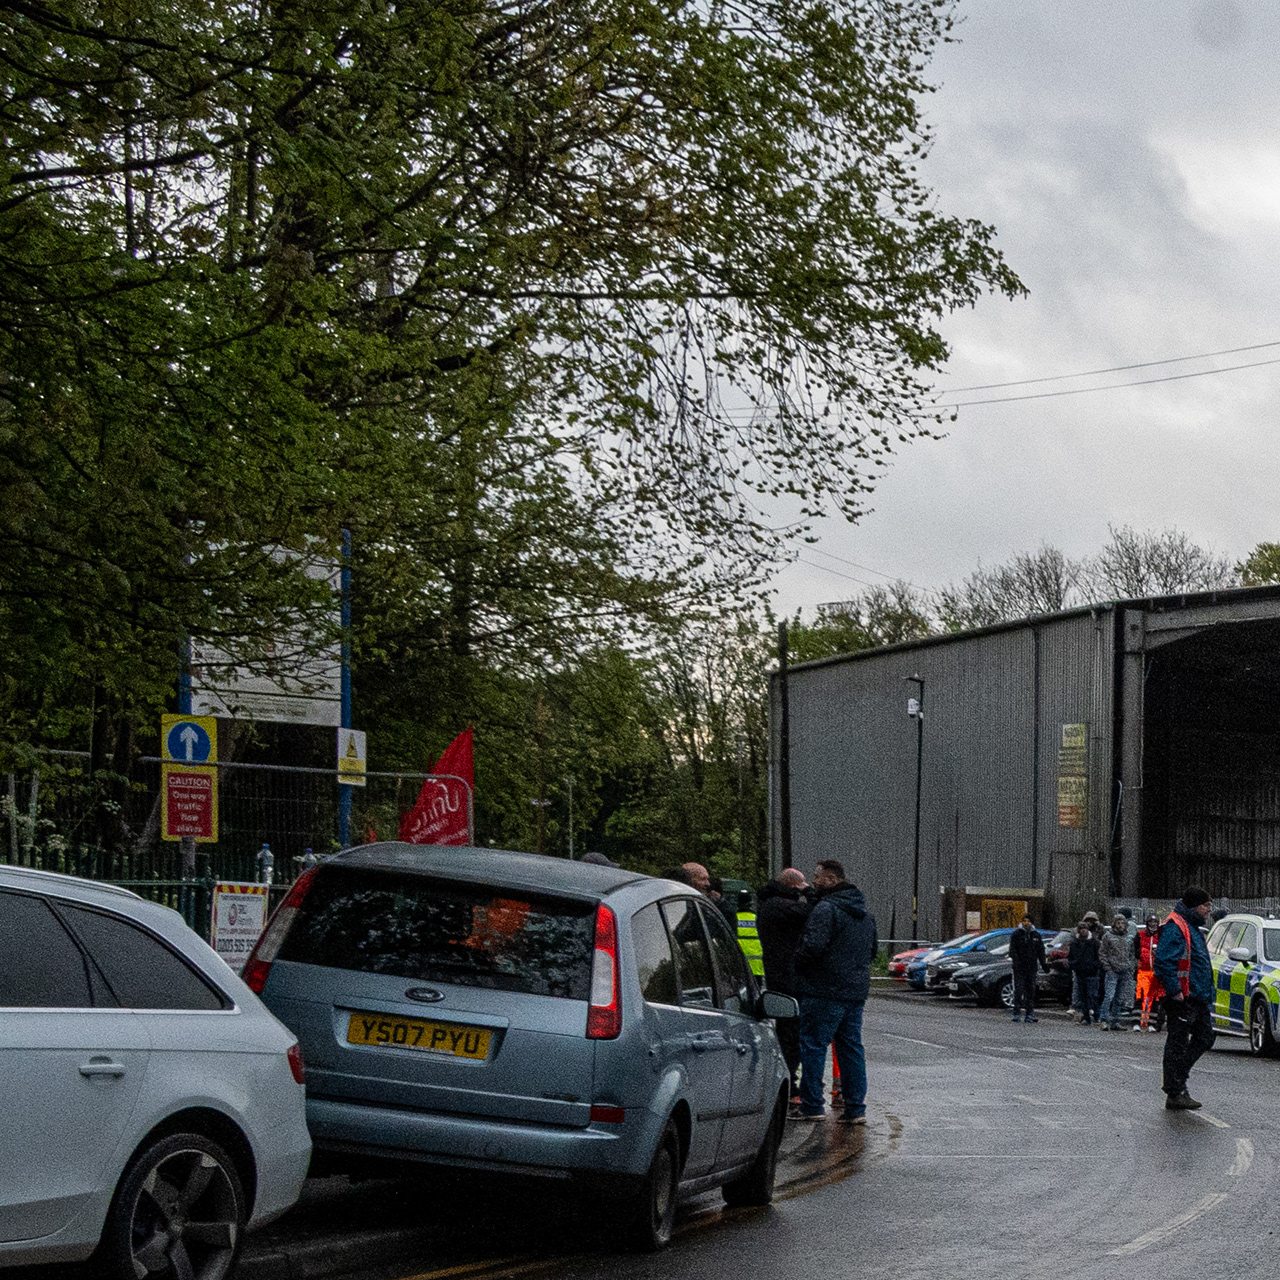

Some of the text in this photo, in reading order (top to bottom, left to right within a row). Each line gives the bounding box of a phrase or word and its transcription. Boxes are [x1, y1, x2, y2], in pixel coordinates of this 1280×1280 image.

[168, 776, 211, 787] CAUTION
[172, 791, 207, 801] One way
[177, 802, 202, 811] traffic
[361, 1019, 425, 1046] YS07
[430, 1028, 481, 1055] PYU
